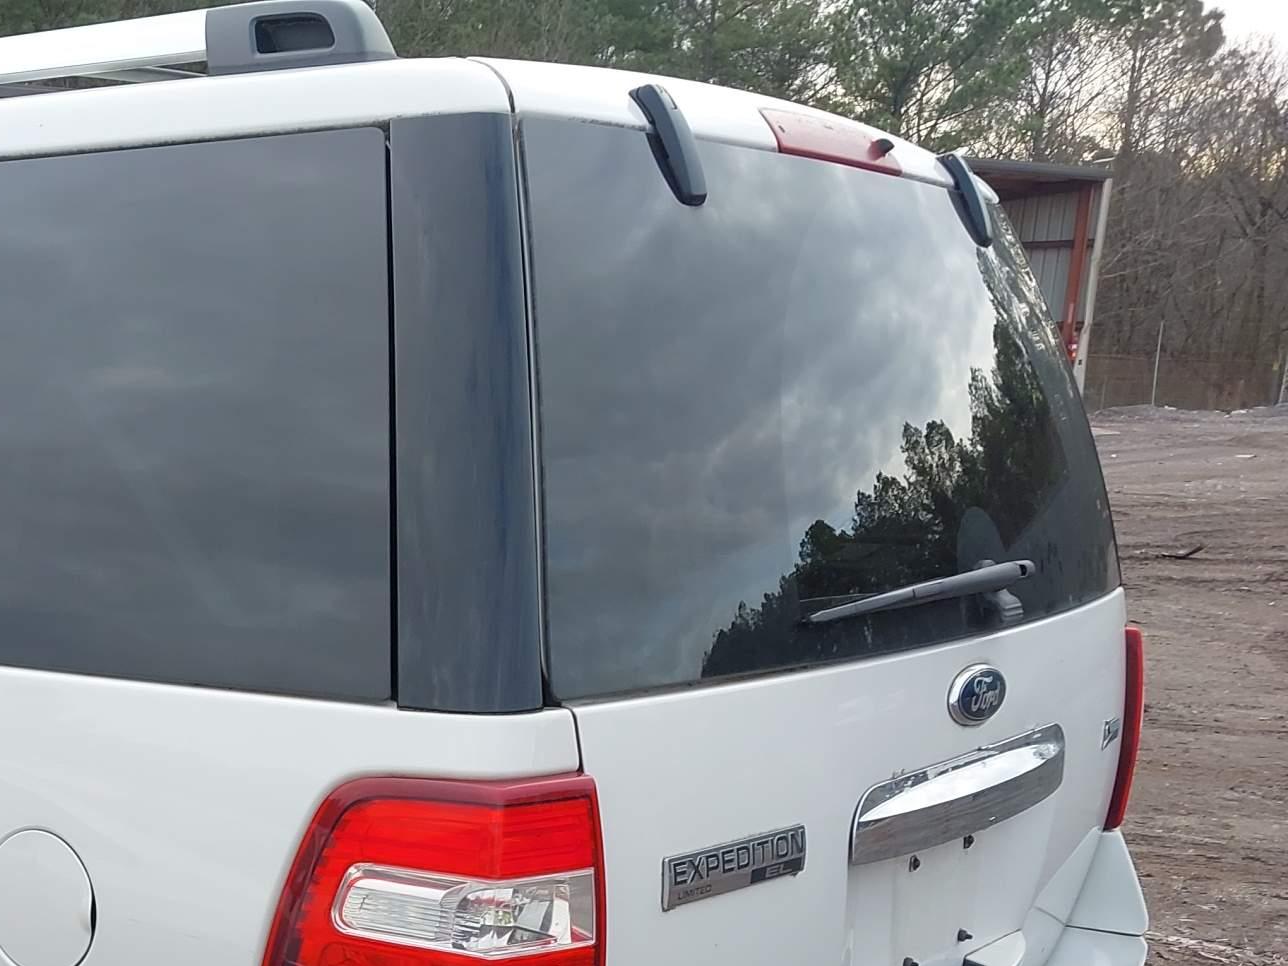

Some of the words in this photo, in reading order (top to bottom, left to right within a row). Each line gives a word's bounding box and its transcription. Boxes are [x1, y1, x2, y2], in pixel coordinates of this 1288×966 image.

[971, 675, 1001, 712] Ford
[670, 828, 805, 887] EXPEDITION
[765, 862, 793, 879] EL
